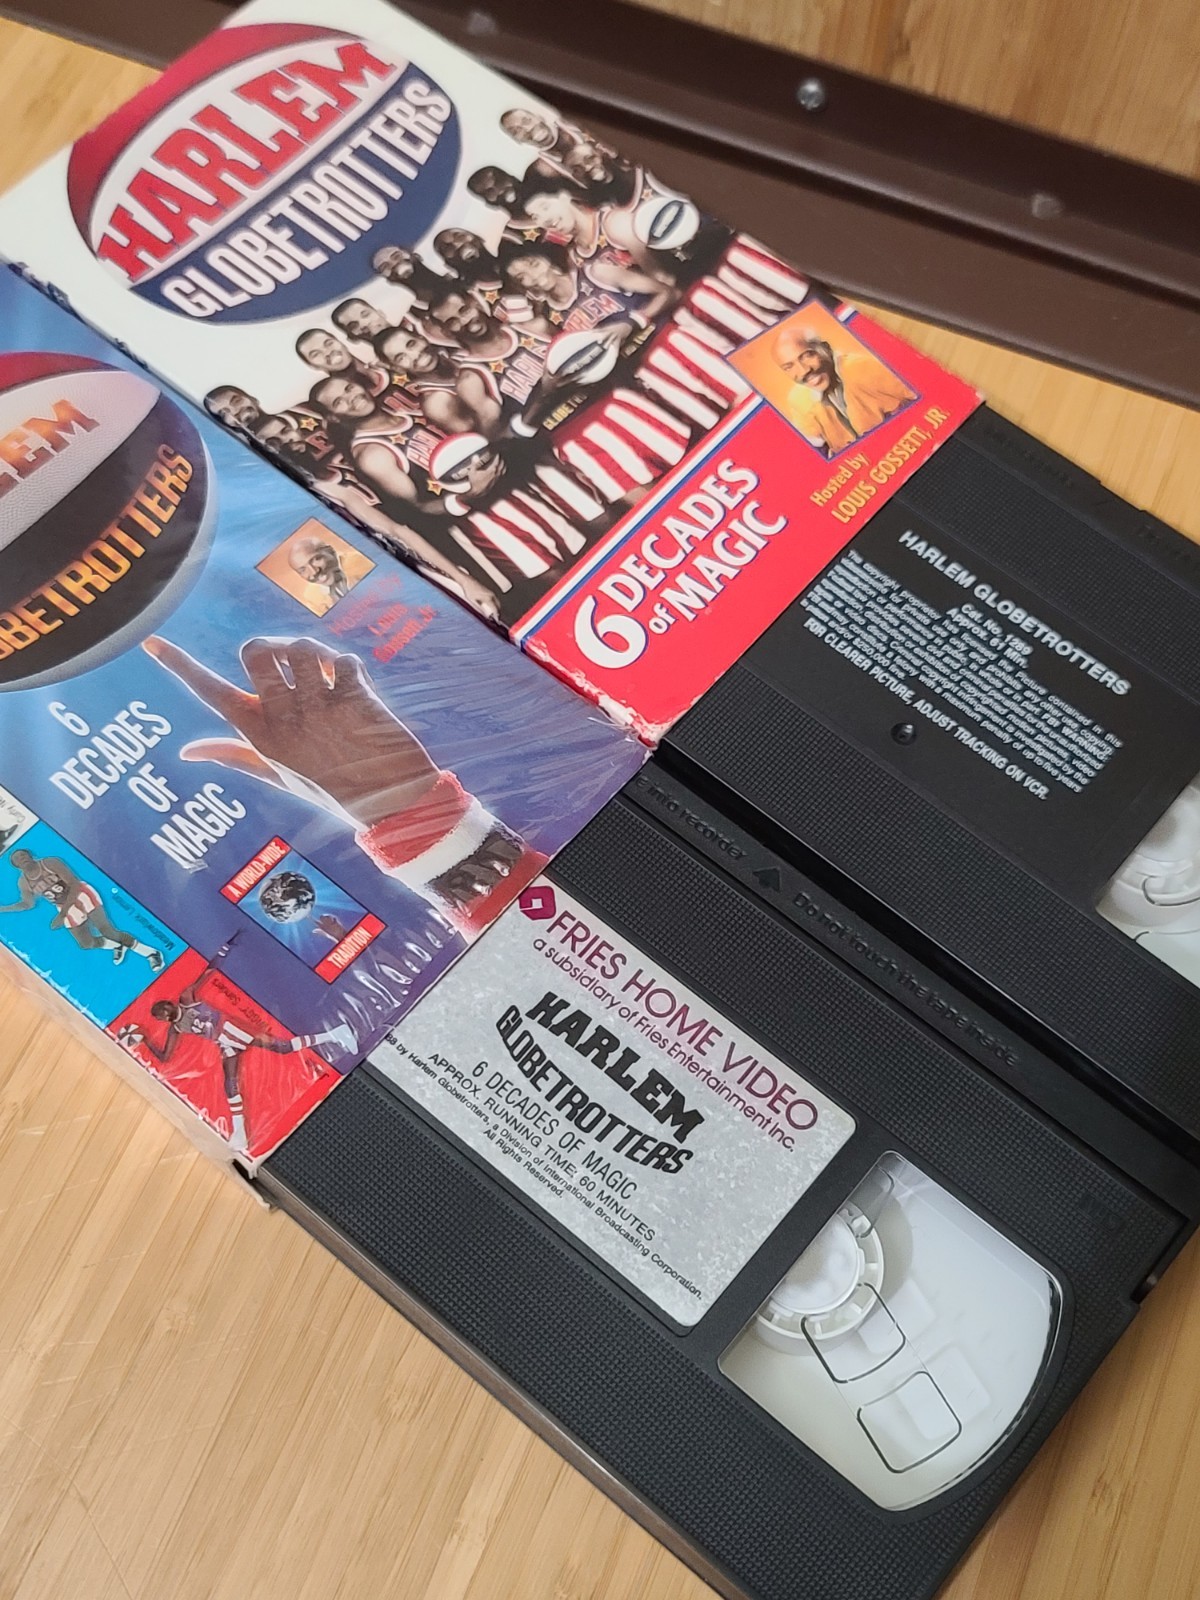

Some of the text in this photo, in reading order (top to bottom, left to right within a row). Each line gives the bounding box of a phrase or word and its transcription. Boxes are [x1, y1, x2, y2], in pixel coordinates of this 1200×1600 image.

[96, 42, 398, 284] HARLEM
[162, 77, 451, 318] GLOBETROTTERS
[809, 451, 869, 507] Hosted by
[830, 479, 876, 523] LOUIS
[868, 423, 932, 484] GOSSETT,
[574, 458, 760, 669] 6 DECADES
[648, 602, 676, 635] of
[660, 501, 789, 622] MAGIC
[898, 530, 976, 588] HARLEM
[973, 582, 1130, 696] GLOBETROTTERS
[960, 602, 984, 623] Cat.
[833, 599, 844, 608] or
[843, 606, 866, 625] video
[889, 640, 923, 667] Criminal
[920, 664, 959, 693] copyright
[1013, 729, 1064, 767] investigated
[1061, 763, 1075, 776] by
[1072, 771, 1089, 785] the
[851, 636, 891, 667] $250,000
[862, 562, 899, 590] copyright
[899, 590, 941, 621] proprietor
[1014, 670, 1047, 695] Picture
[1047, 694, 1092, 726] contained
[1091, 724, 1102, 734] in
[1104, 733, 1122, 748] this
[863, 609, 906, 643] distribution
[904, 640, 916, 649] or
[912, 646, 952, 676] exhibition
[949, 672, 962, 682] of
[958, 679, 1008, 716] copyrighted
[1006, 712, 1036, 735] motion
[1070, 758, 1096, 777] video
[865, 599, 900, 626] provides
[925, 643, 945, 658] civil
[941, 655, 961, 670] and
[958, 667, 991, 692] criminal
[1024, 712, 1038, 724] for
[1035, 720, 1051, 734] the
[1048, 730, 1103, 770] unauthorized
[876, 595, 887, 604] or
[884, 602, 935, 640] performance
[933, 636, 944, 646] in
[968, 661, 980, 671] in
[1002, 686, 1014, 696] or
[1012, 692, 1022, 701] in
[1041, 712, 1061, 728] FBI
[888, 592, 902, 604] for
[901, 602, 931, 625] private
[931, 624, 948, 638] use
[948, 636, 968, 655] only
[985, 663, 1023, 690] prohibits
[1023, 689, 1040, 704] any
[1039, 700, 1063, 718] other
[945, 606, 1029, 668] Approx. 61 Min.
[48, 701, 90, 738] 6
[48, 700, 173, 810] DECADES
[803, 616, 1050, 800] FOR CLEARER PICTURE, ADJUST TRACKING ON VCR.
[892, 654, 920, 677] felony
[917, 673, 937, 689] with
[941, 690, 982, 722] maximum
[979, 718, 1014, 745] penalty
[1011, 740, 1025, 751] of
[1021, 748, 1035, 760] up
[1033, 755, 1044, 766] to
[1041, 761, 1059, 776] five
[1055, 772, 1082, 793] years
[126, 762, 179, 813] OF
[149, 782, 246, 870] MAGIC
[682, 803, 749, 861] recorder
[226, 838, 286, 898] A WORLD-WIDE
[325, 923, 373, 971] TRADITION
[526, 991, 705, 1144] HARLEM
[532, 937, 797, 1152] a subsidiary of Fries Entertainment Inc.
[546, 909, 820, 1132] FRIES HOME VIDEO
[427, 1052, 656, 1242] APPROX. RUNNING TIME: 60 MINUTES
[470, 1059, 637, 1200] 6 DECADES OF MAGIC
[495, 1004, 694, 1174] GLOBETROTTERS
[394, 1042, 408, 1056] by
[407, 1052, 438, 1079] Harlem
[436, 1076, 491, 1125] Globetrotters,
[499, 1128, 533, 1158] Division
[532, 1156, 544, 1166] of
[542, 1163, 596, 1209] International
[593, 1206, 651, 1256] Broadcasting
[649, 1252, 703, 1300] Corporation.
[482, 1128, 565, 1198] All Rights Reserved.
